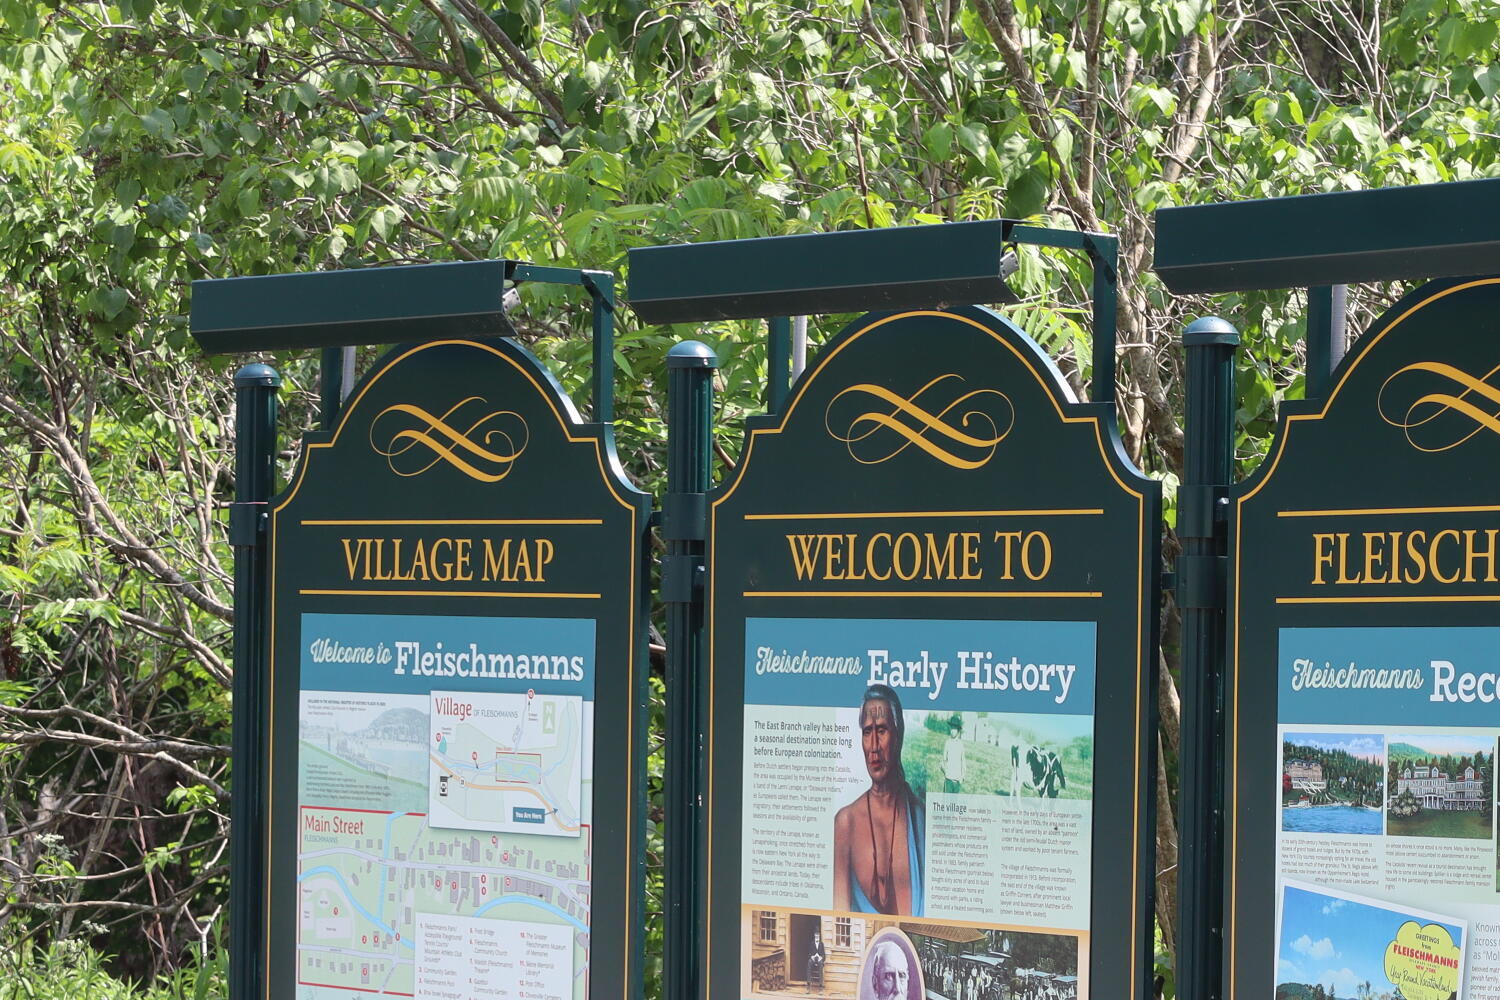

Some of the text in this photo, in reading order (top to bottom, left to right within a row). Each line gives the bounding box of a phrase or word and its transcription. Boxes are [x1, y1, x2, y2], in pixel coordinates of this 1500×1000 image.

[341, 538, 554, 583] VILLAGE MAP
[786, 530, 1052, 581] WELCOME TO
[310, 638, 584, 681] Welcome to Fleischmanns
[755, 646, 1075, 703] Fleischmanns Early History
[1291, 659, 1424, 691] Fleischmanns
[435, 698, 472, 721] Village
[754, 721, 849, 733] The East Branch valley has been
[759, 735, 785, 743] seasonal
[787, 735, 820, 744] destination
[822, 736, 837, 745] since
[839, 737, 852, 748] long
[754, 747, 842, 758] before European colonization.
[933, 802, 966, 815] The village
[305, 815, 363, 835] Main Street
[1476, 922, 1500, 932] Known
[1416, 933, 1439, 944] GREETINGS
[1475, 938, 1497, 947] across
[1394, 945, 1458, 968] FLEISCHMANNS
[1473, 952, 1481, 960] as
